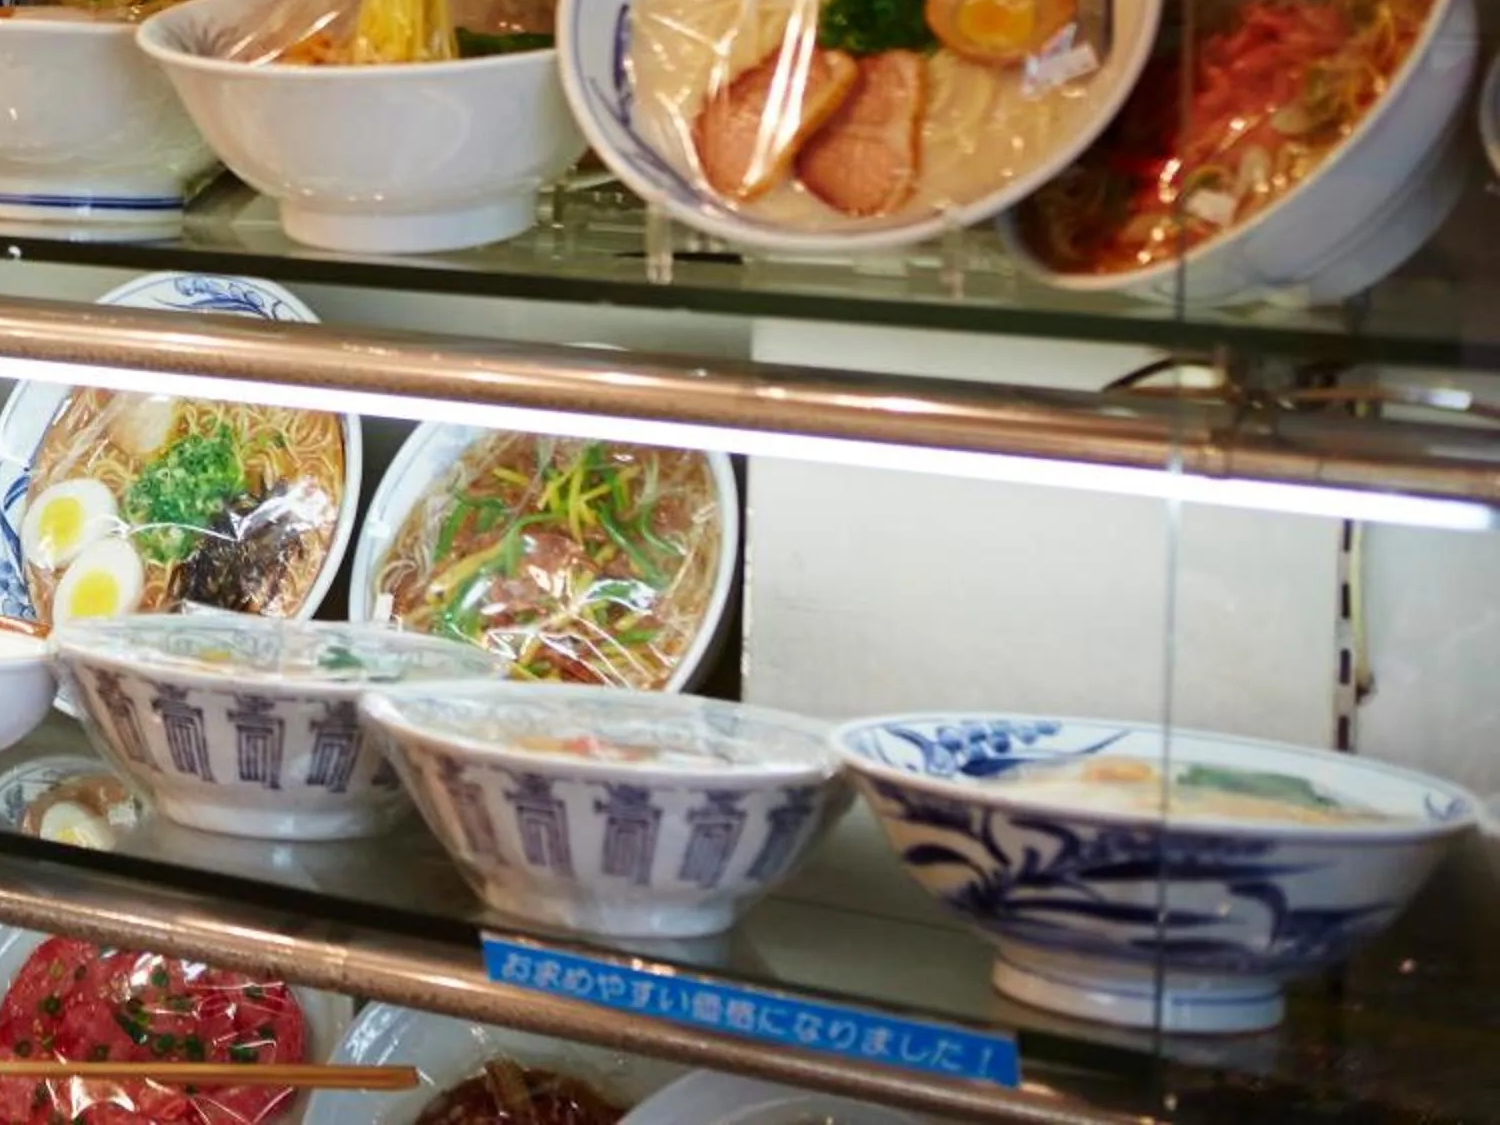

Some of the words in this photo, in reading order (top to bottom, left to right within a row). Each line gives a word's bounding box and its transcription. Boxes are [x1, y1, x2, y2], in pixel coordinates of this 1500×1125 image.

[501, 952, 994, 1075] お求めやすい価格になりました！
